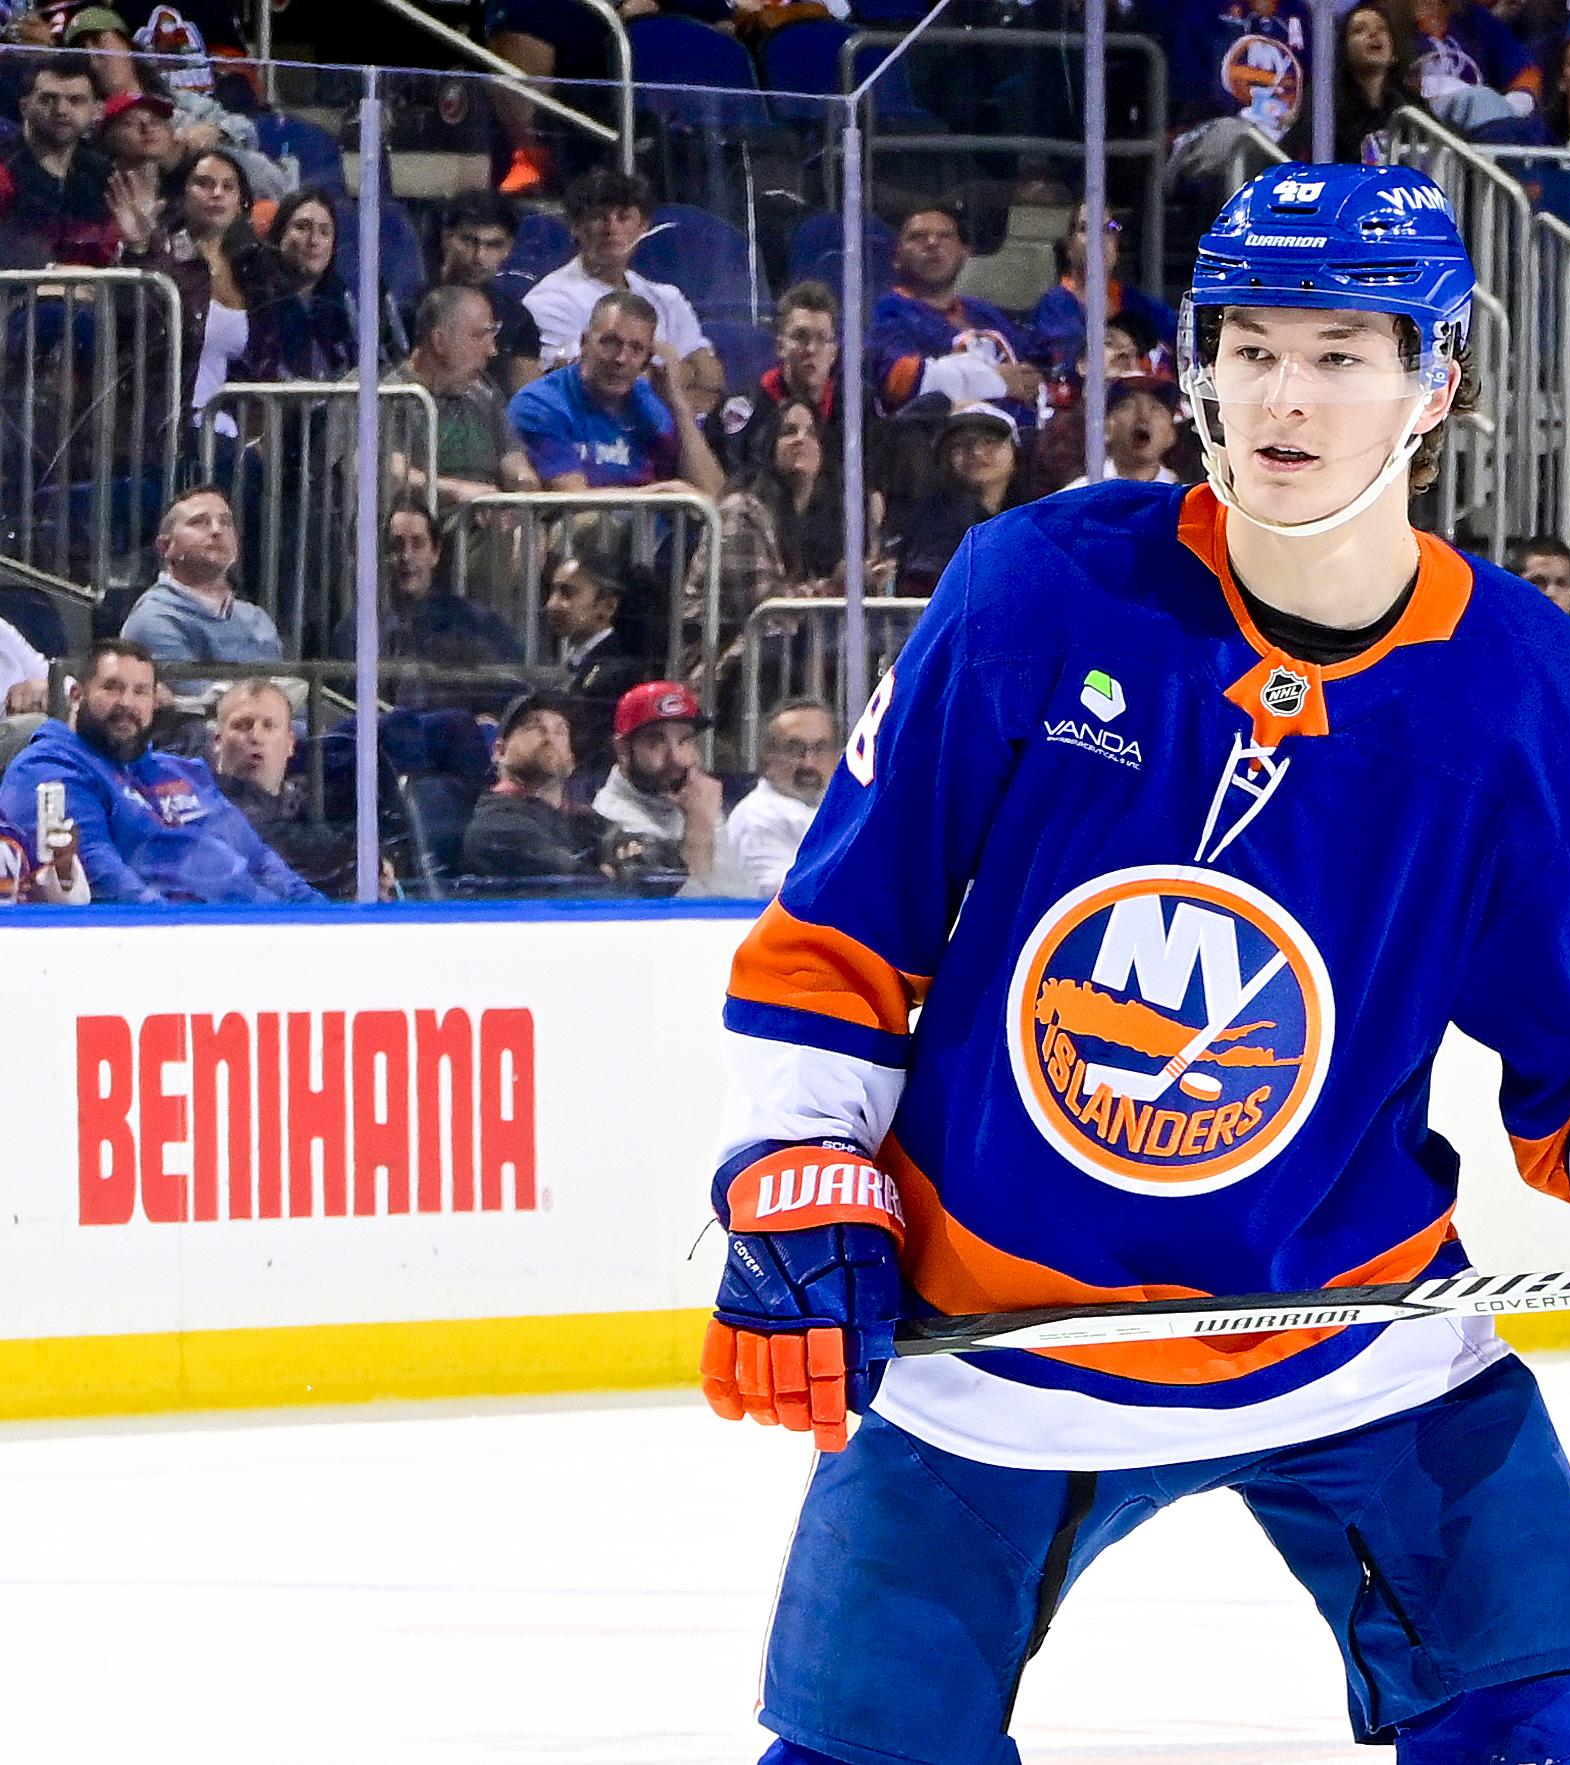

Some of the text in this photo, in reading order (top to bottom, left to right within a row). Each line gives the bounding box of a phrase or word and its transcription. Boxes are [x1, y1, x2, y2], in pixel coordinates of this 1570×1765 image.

[1377, 186, 1446, 210] VIAM
[1245, 235, 1327, 248] WARRIOR
[1268, 685, 1299, 702] NHL
[1044, 720, 1142, 763] VANDA
[1091, 893, 1243, 1028] NY
[1042, 1023, 1273, 1158] ISLANDERS
[76, 1007, 537, 1226] BENIHANA
[732, 1239, 766, 1279] COVERT
[1475, 1295, 1570, 1313] COVERT
[1194, 1309, 1360, 1333] WARRIOR
